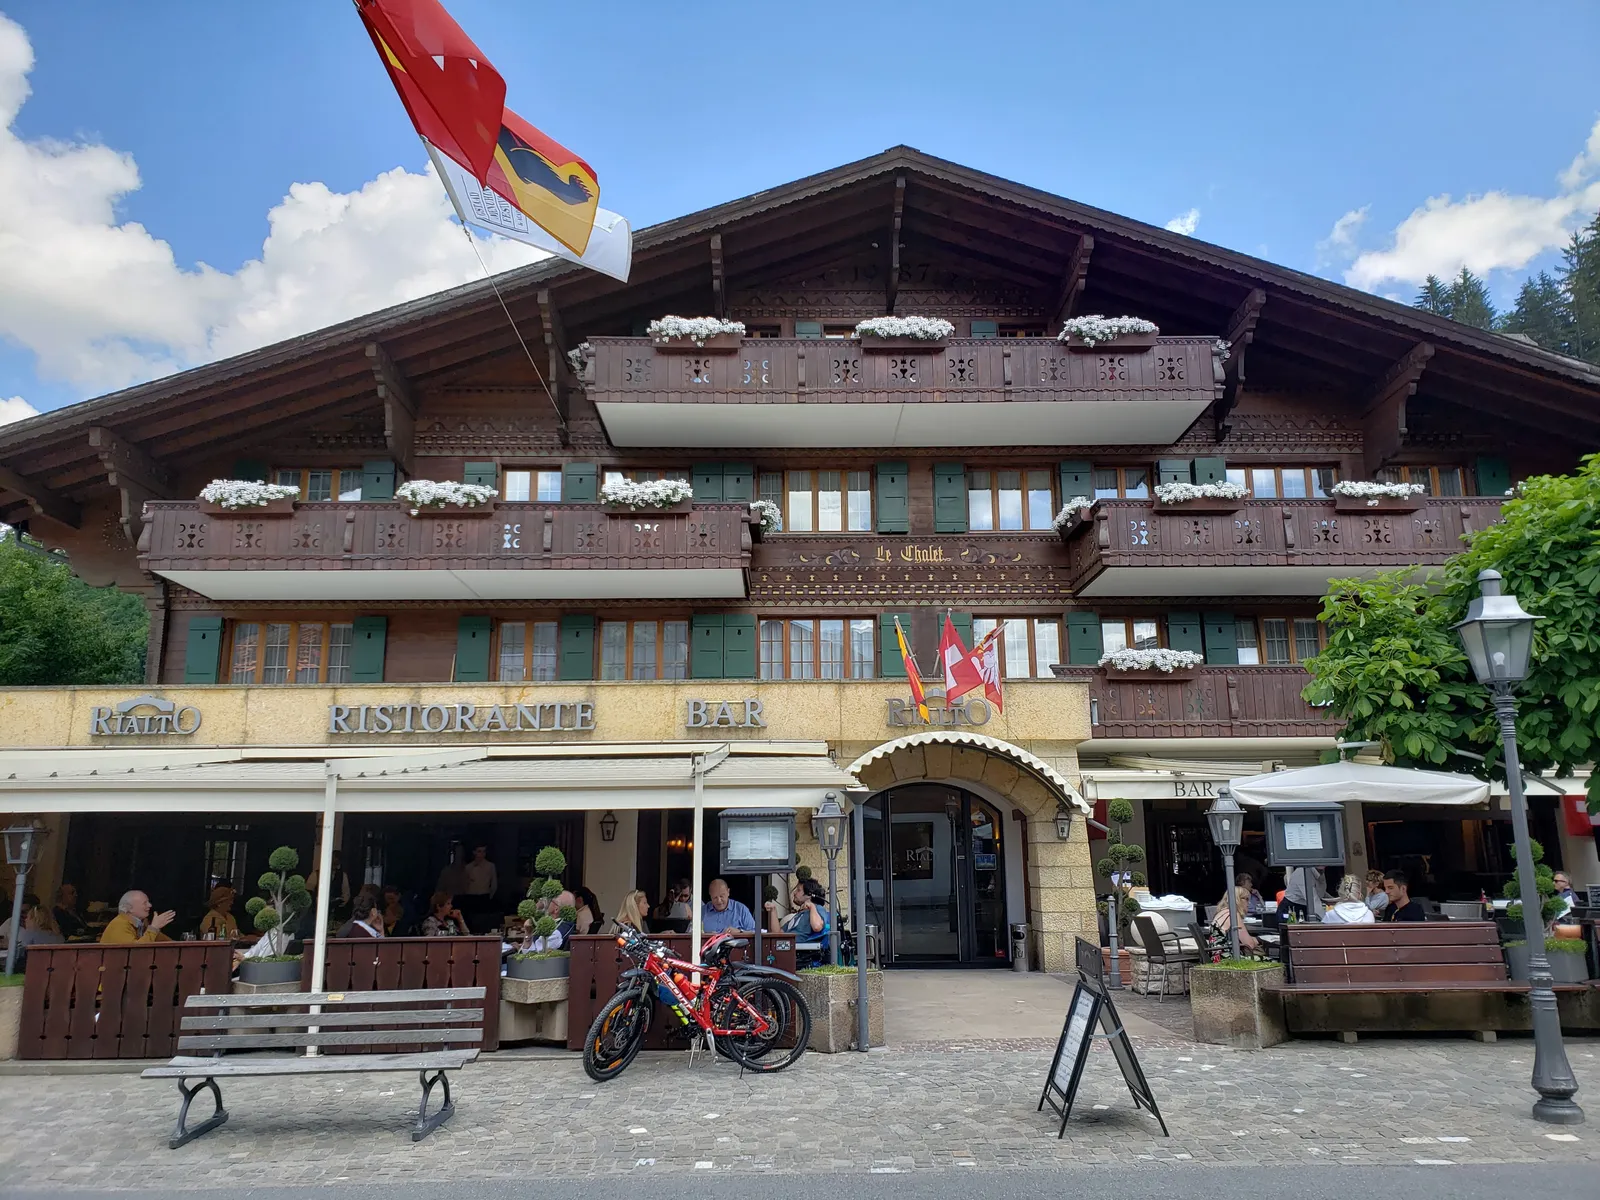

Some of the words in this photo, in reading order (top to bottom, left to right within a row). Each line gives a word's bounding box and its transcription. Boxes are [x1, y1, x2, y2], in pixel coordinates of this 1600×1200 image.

[875, 545, 893, 563] Le
[900, 544, 945, 564] Chalet
[88, 705, 202, 735] RIALTO
[327, 702, 597, 734] RISTORANTE
[685, 698, 767, 728] BAR
[1173, 781, 1215, 797] BAR
